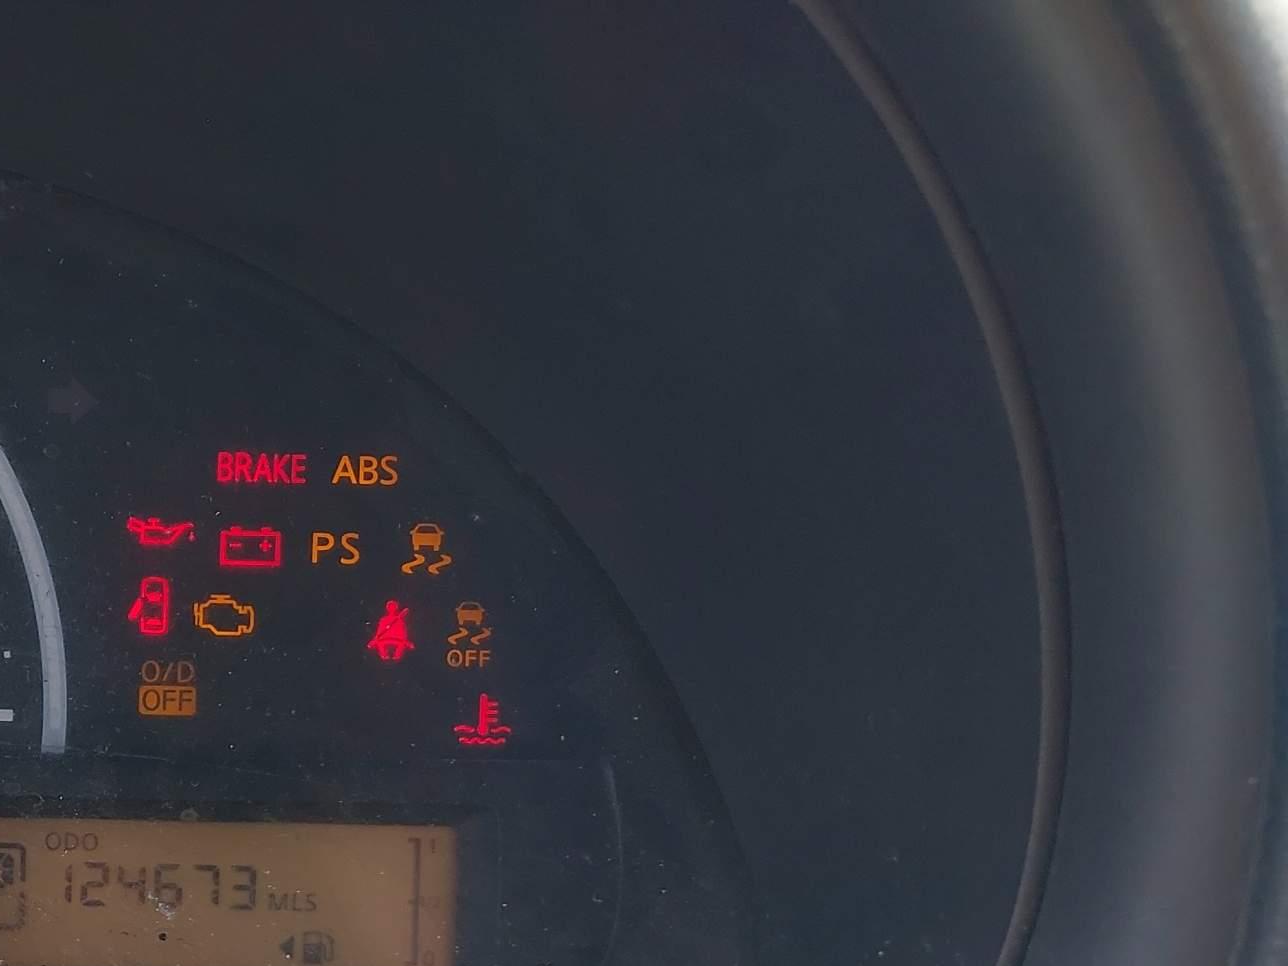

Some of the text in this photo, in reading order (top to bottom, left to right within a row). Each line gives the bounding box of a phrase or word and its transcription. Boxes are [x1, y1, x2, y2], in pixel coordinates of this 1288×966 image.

[217, 451, 307, 485] BRAKE
[331, 455, 399, 486] ABS
[312, 532, 361, 565] PS
[141, 660, 196, 684] O/D
[446, 649, 492, 668] OFF
[142, 689, 194, 712] OFF
[45, 832, 99, 851] ODO
[64, 861, 318, 912] 124673 MLS
